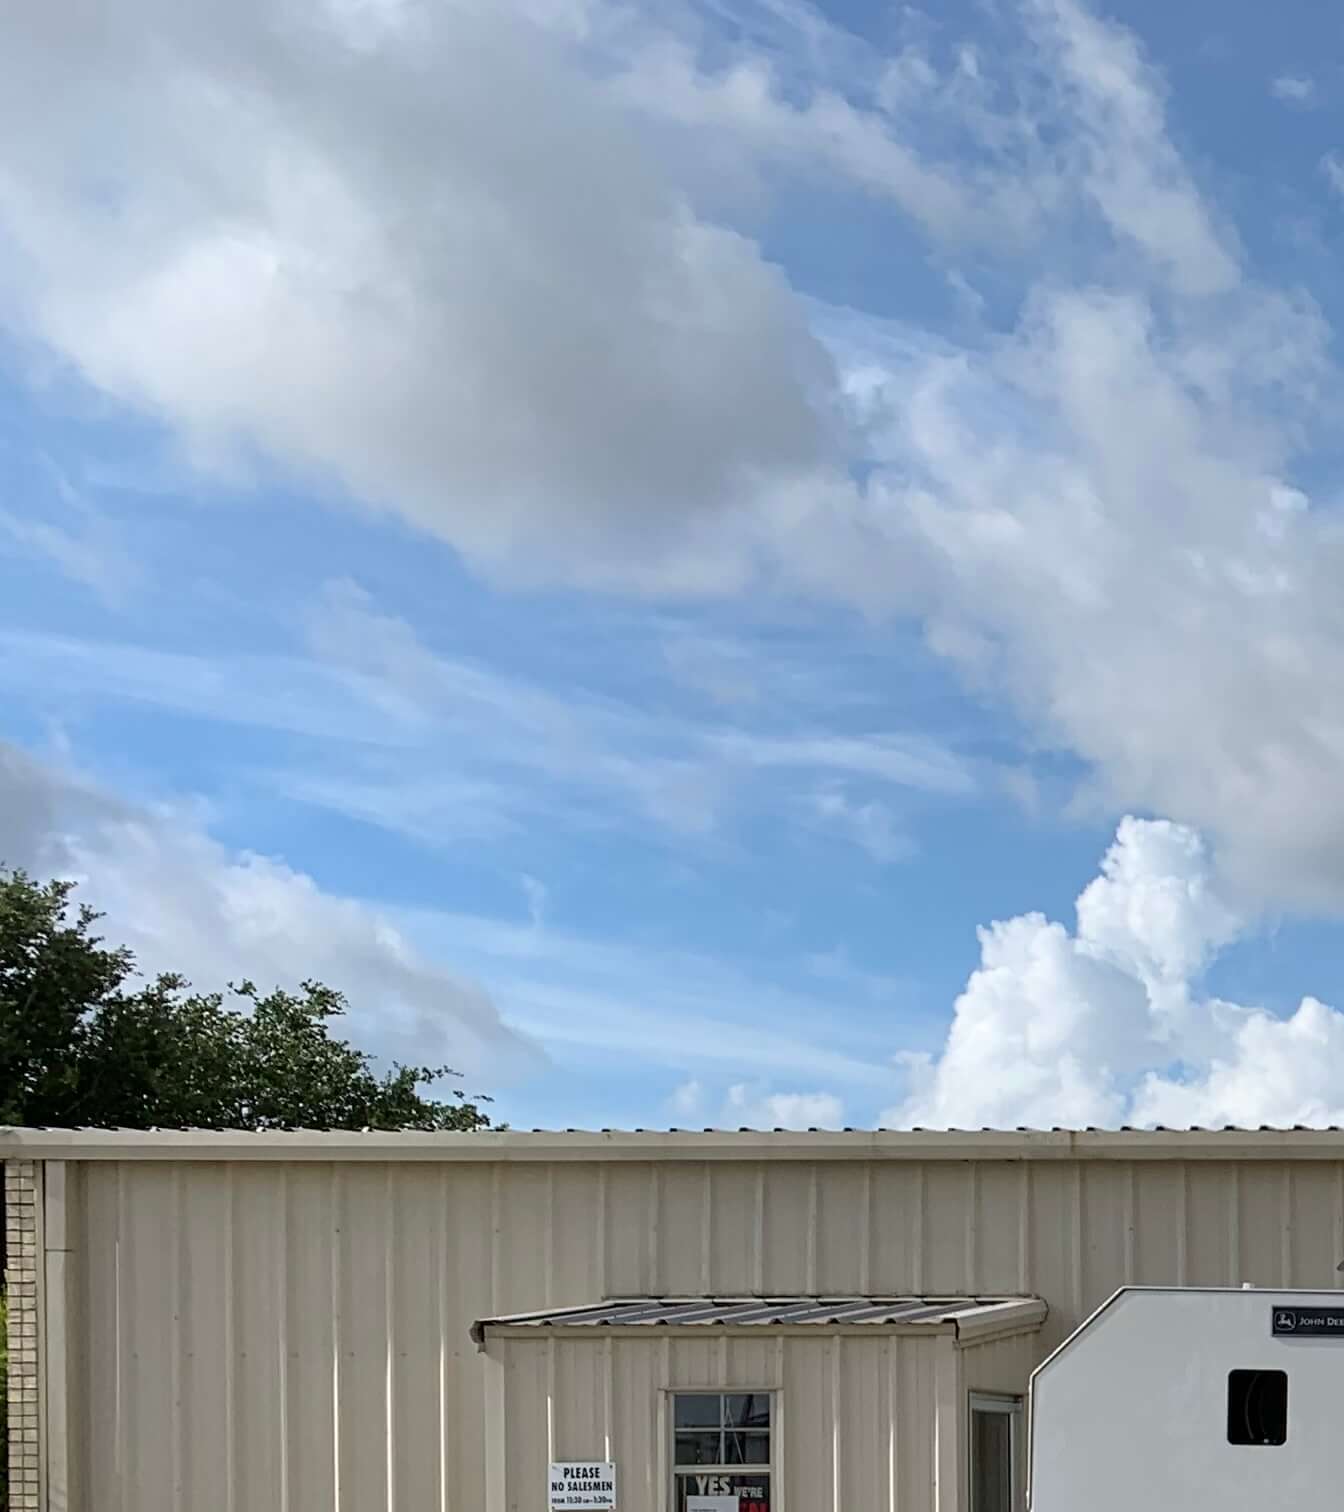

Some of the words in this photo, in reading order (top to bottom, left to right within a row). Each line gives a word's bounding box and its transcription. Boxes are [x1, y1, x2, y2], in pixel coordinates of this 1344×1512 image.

[1299, 1317, 1324, 1327] JOHN
[564, 1467, 600, 1478] PLEASE
[552, 1482, 564, 1491] NO
[568, 1482, 612, 1491] SALESMEN
[696, 1475, 731, 1496] YES
[734, 1486, 763, 1498] WE'RE
